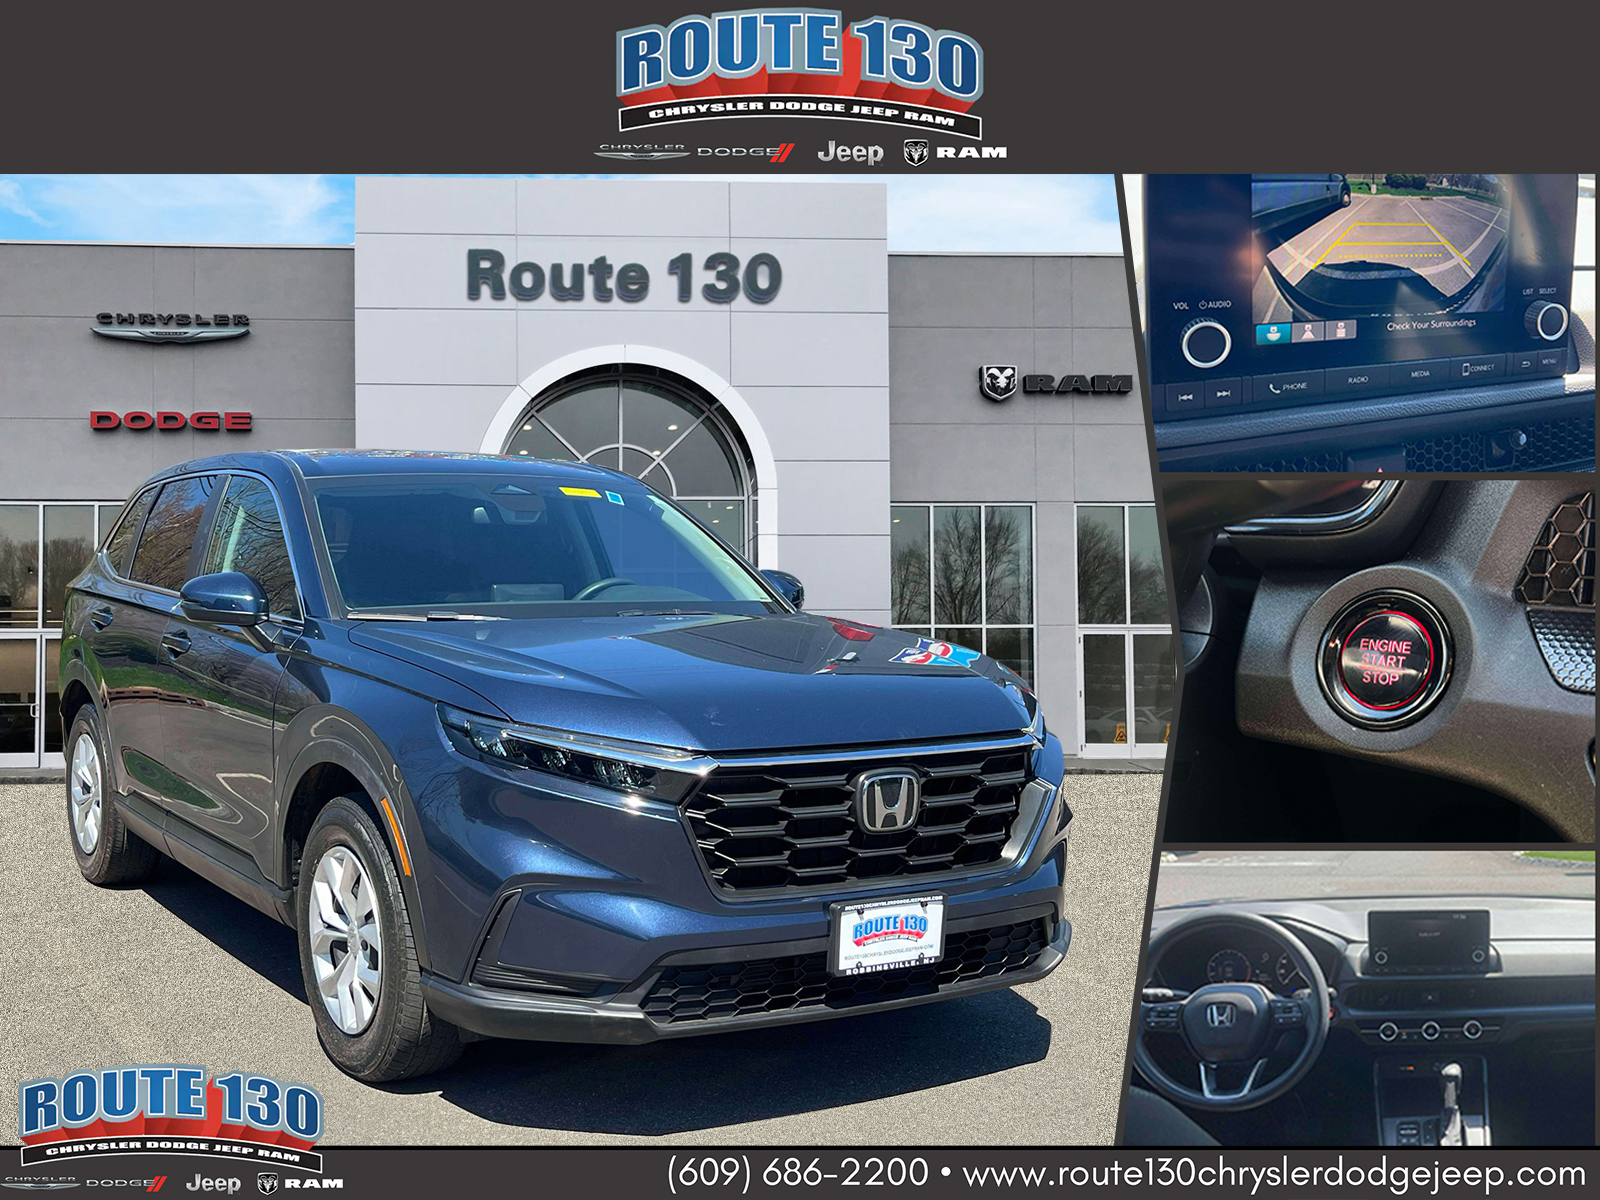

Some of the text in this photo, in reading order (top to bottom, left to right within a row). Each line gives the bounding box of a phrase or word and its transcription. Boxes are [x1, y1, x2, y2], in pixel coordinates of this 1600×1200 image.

[466, 248, 783, 304] Route 130
[1522, 287, 1557, 296] LIST SELECT
[1172, 300, 1232, 310] VOL AUDIO
[95, 312, 250, 326] CHRYSLER
[1386, 318, 1477, 332] Check Your Surroundings
[1410, 369, 1431, 378] MEDIA
[1470, 363, 1496, 373] CONNECT
[1022, 374, 1134, 394] RAM
[1282, 381, 1308, 391] PHONE
[1347, 375, 1370, 385] RADIO
[90, 410, 253, 432] DODGE
[1359, 637, 1413, 655] ENGINE
[1361, 653, 1406, 669] START
[1362, 670, 1400, 686] STOP
[854, 915, 900, 940] ROUTE
[902, 914, 928, 933] 130
